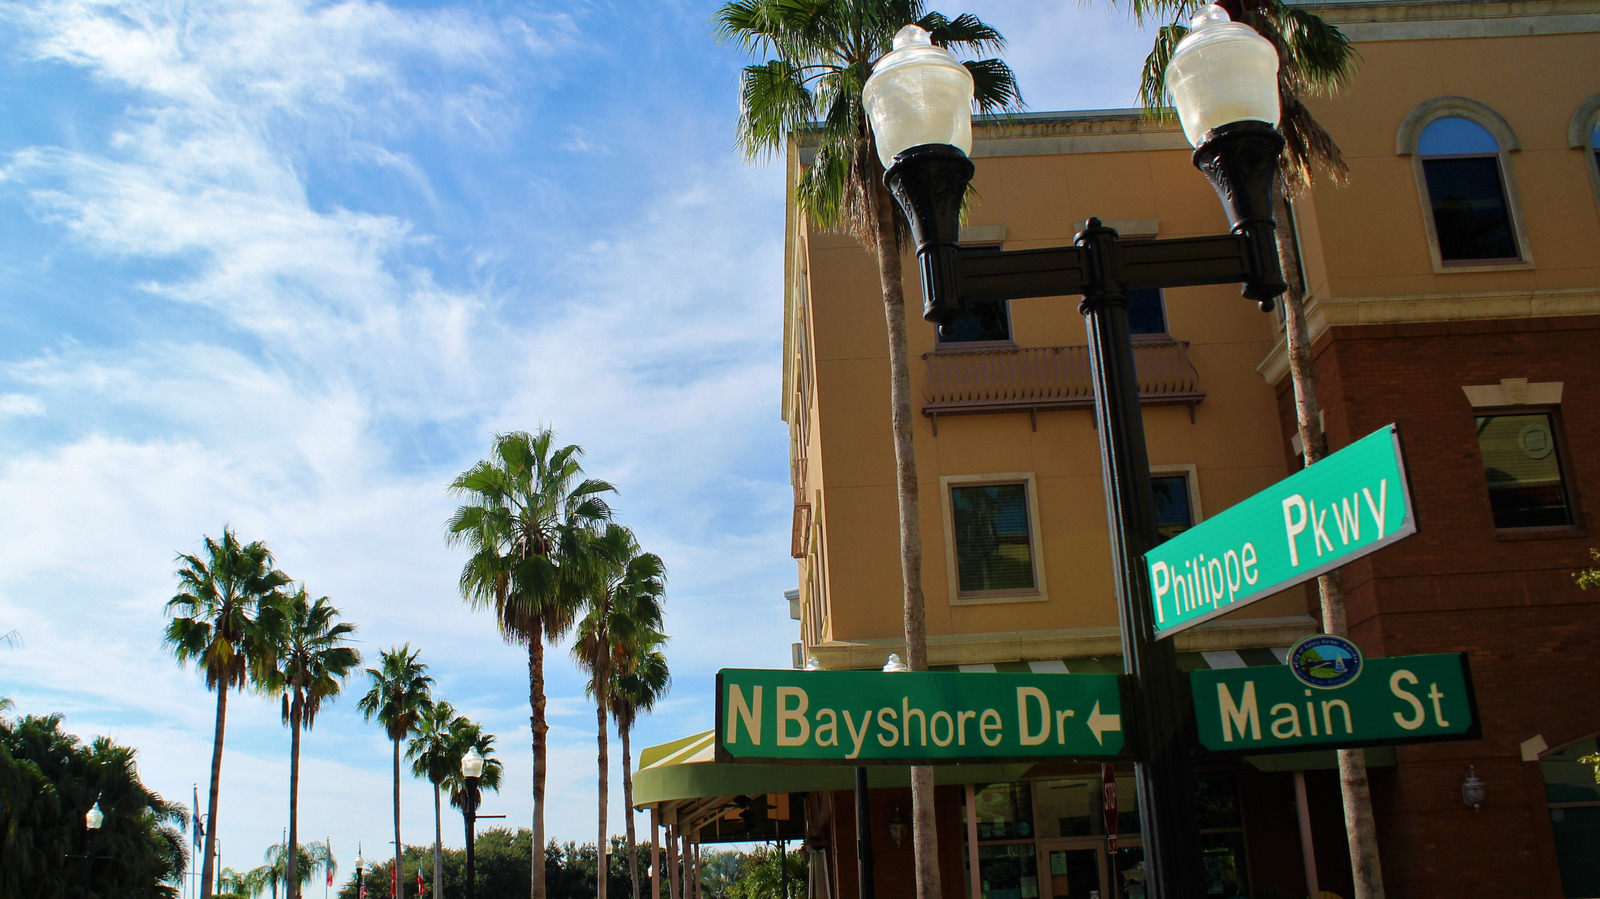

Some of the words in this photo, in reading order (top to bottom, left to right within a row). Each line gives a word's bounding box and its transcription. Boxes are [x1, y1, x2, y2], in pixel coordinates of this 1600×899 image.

[1151, 542, 1259, 624] Philippe
[1282, 478, 1387, 567] Pkwy
[726, 683, 763, 745] N
[776, 685, 1002, 760] Bayshore
[1016, 686, 1075, 746] Dr
[1216, 680, 1353, 742] Main
[1389, 669, 1450, 730] St
[1104, 782, 1117, 811] STOP
